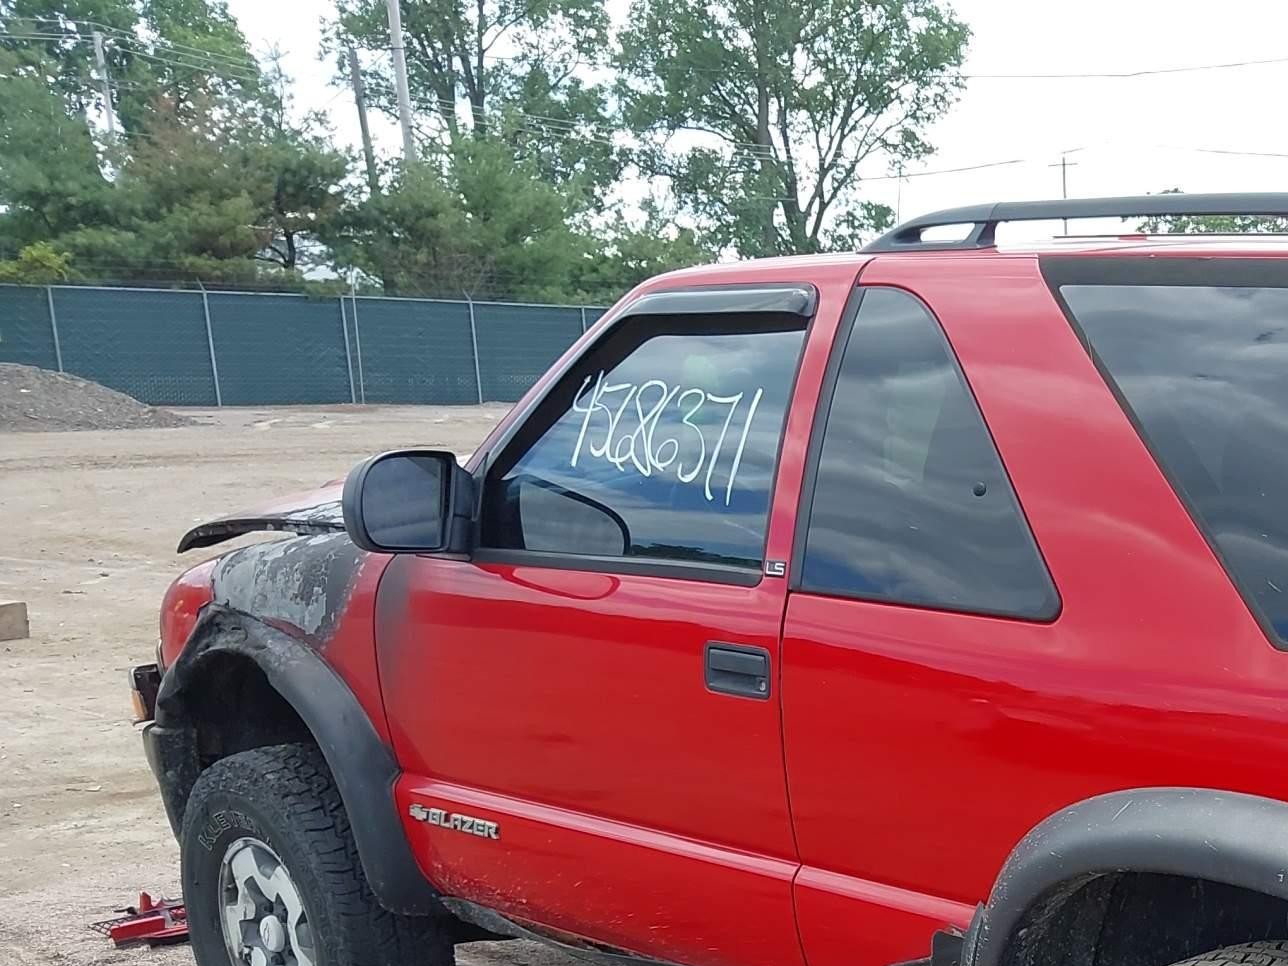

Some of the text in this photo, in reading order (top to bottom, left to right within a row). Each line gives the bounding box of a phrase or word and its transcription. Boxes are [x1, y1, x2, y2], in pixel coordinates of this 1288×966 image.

[570, 370, 763, 506] 45686371
[765, 561, 785, 576] LS
[428, 807, 500, 840] BLAZER
